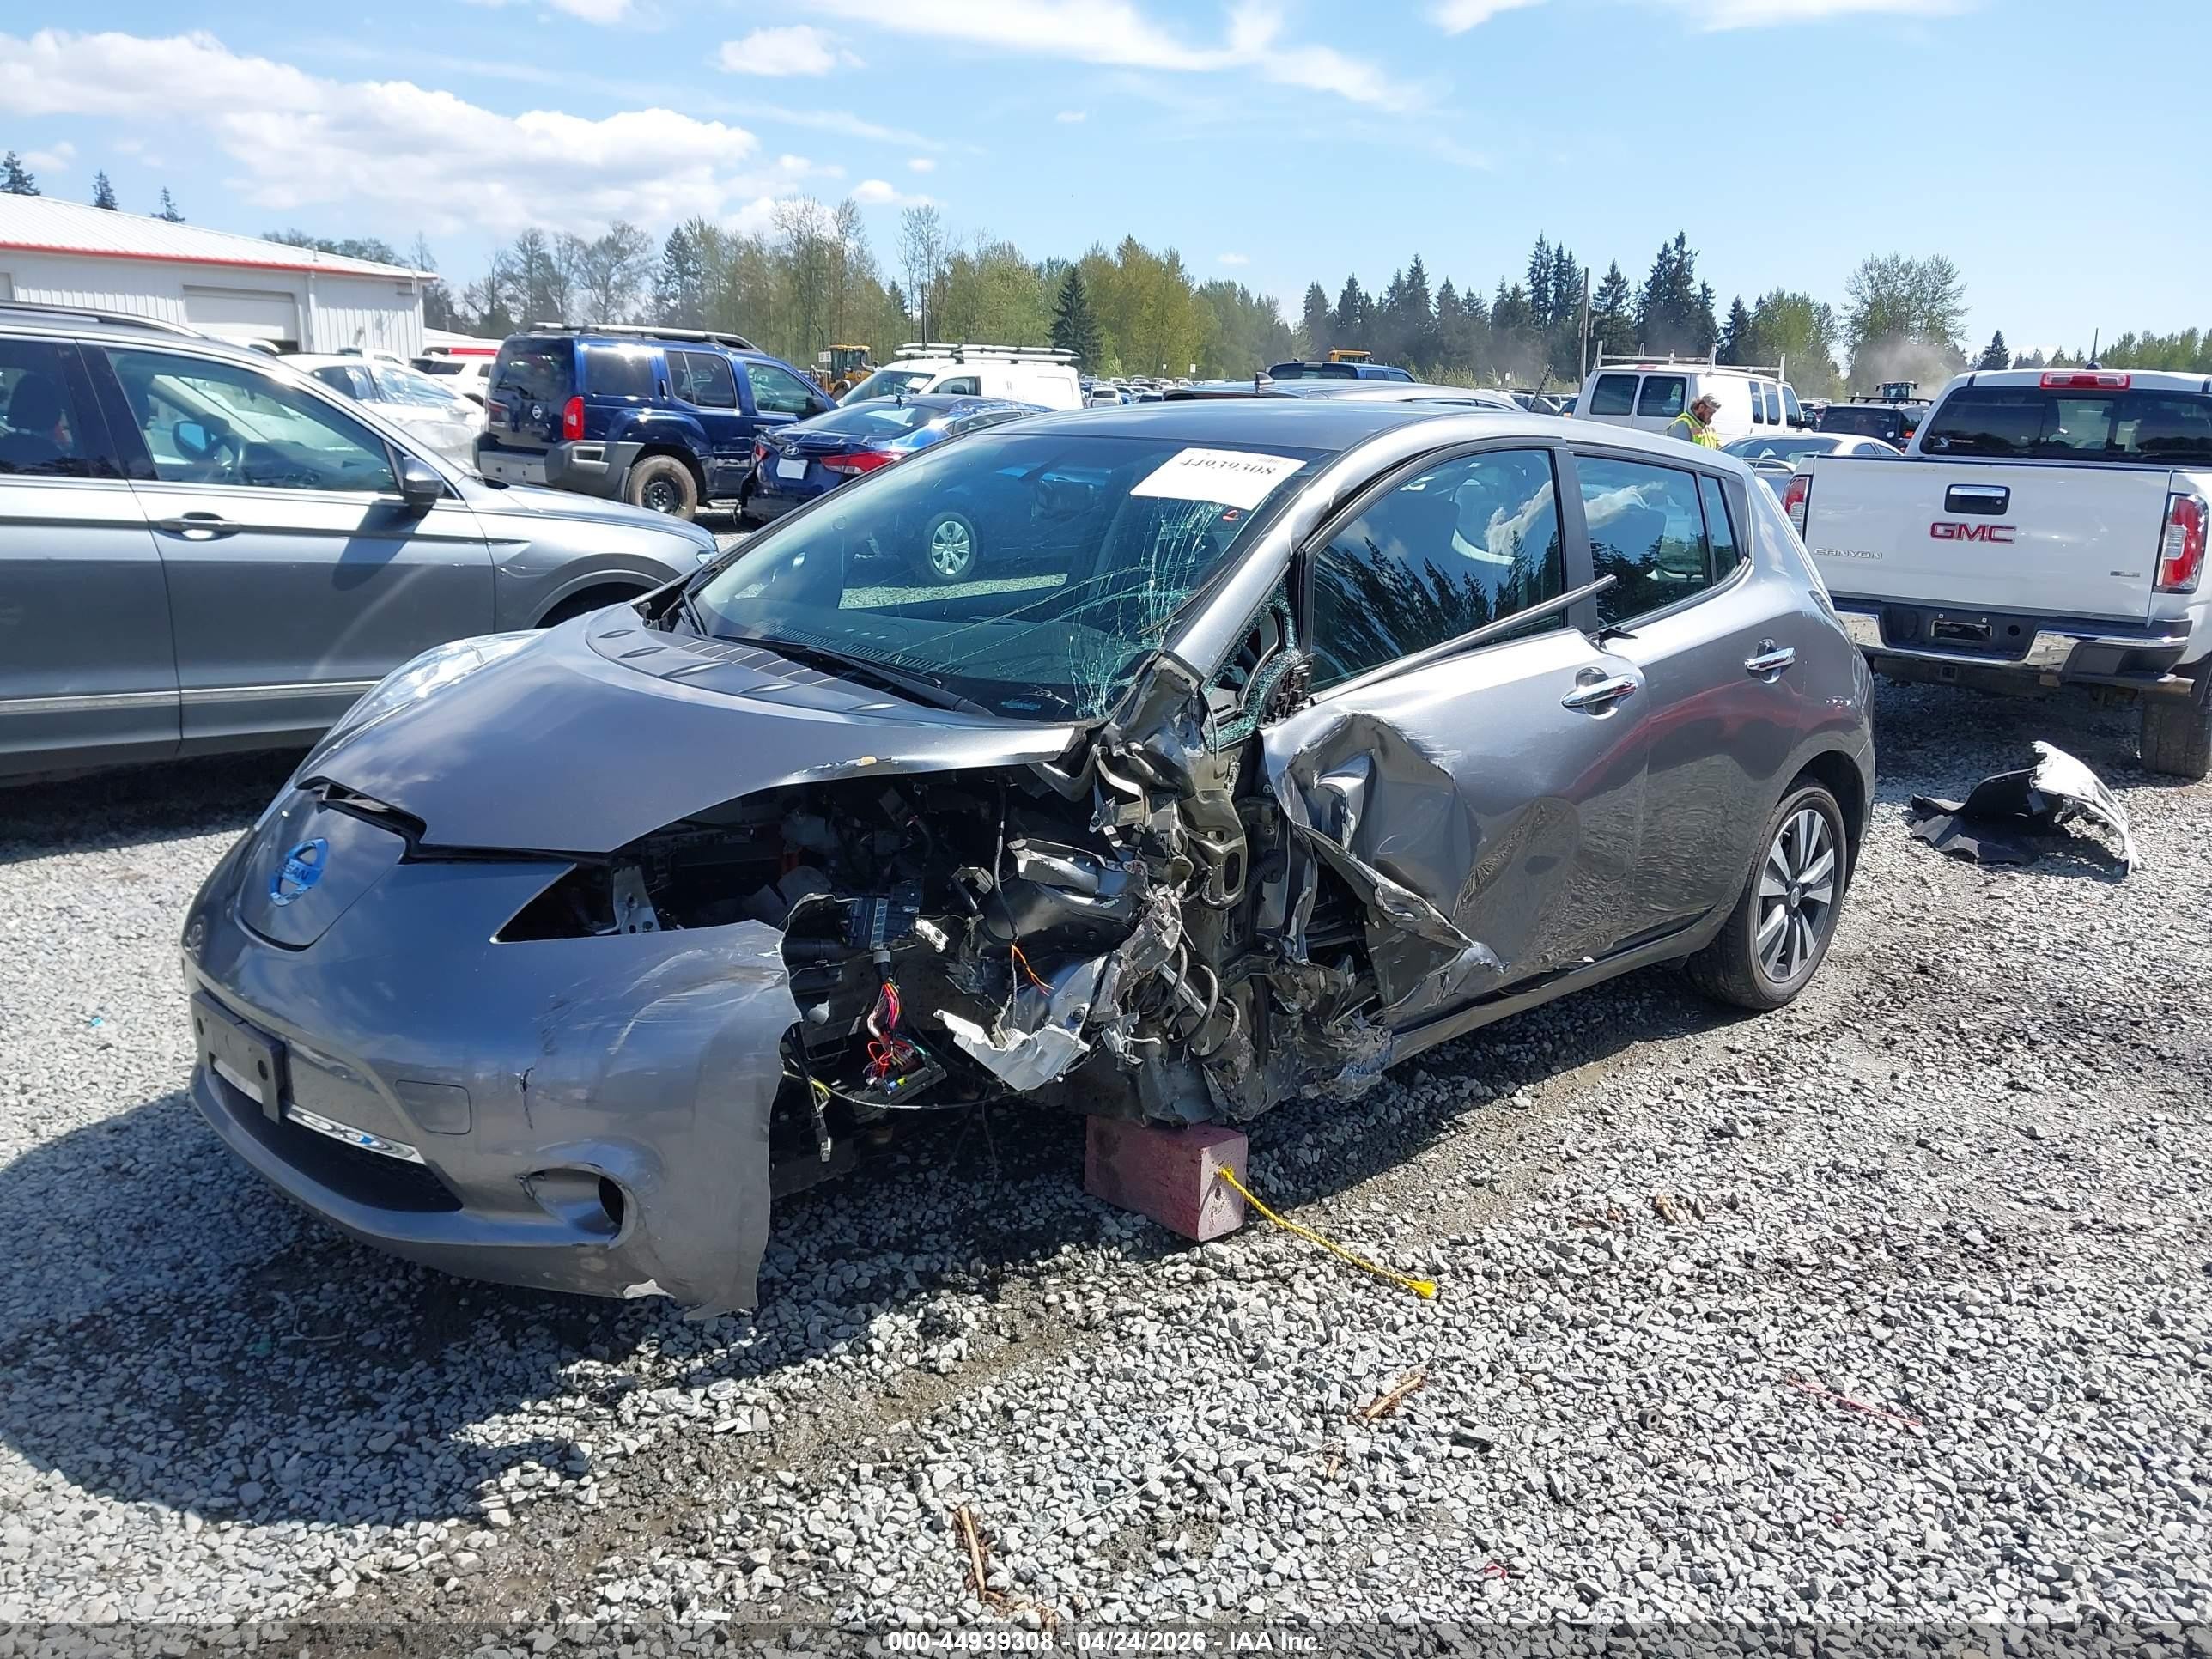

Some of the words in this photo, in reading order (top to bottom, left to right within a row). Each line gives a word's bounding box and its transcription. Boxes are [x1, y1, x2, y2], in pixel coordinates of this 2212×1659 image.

[1181, 458, 1276, 475] 44939308
[1930, 522, 2016, 544] GMC
[1814, 547, 1884, 559] CANYON
